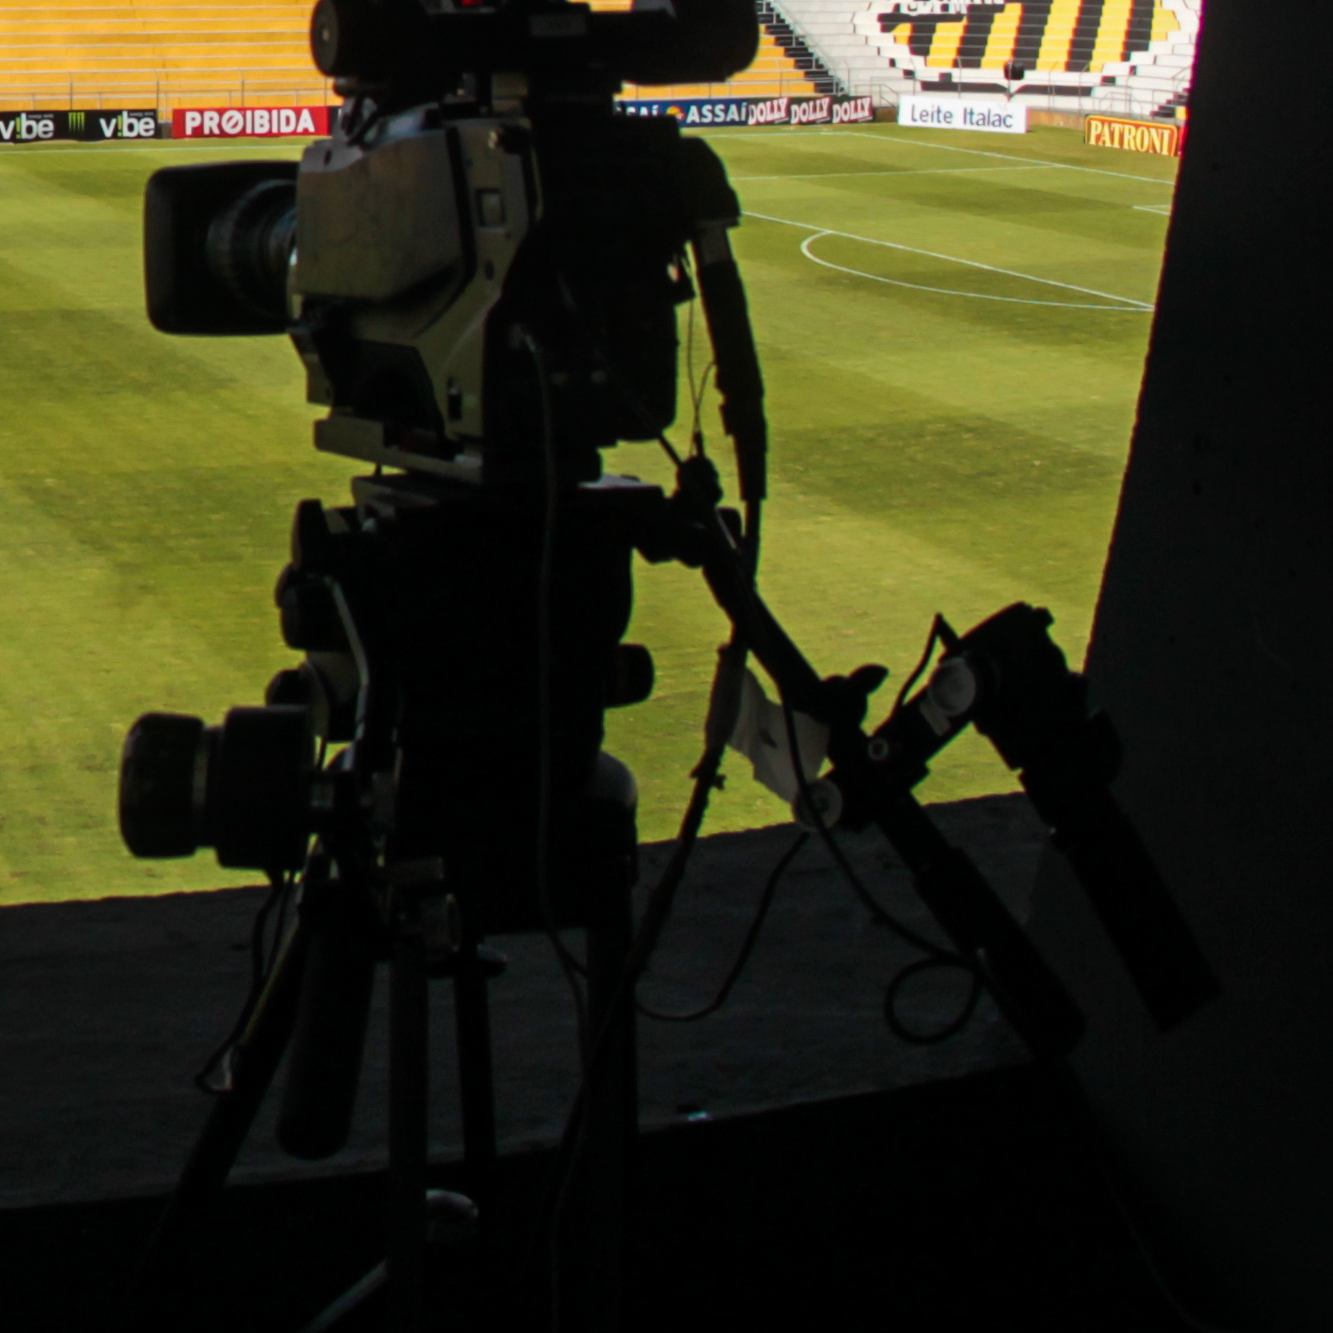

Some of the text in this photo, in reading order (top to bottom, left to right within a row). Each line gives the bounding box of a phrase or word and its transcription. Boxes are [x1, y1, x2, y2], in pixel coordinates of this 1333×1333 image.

[749, 97, 789, 126] DOLLY
[791, 97, 831, 125] DOLLY
[832, 97, 871, 124] DOLLY
[911, 103, 1013, 129] Leite Italac
[1089, 119, 1171, 155] PATRONI
